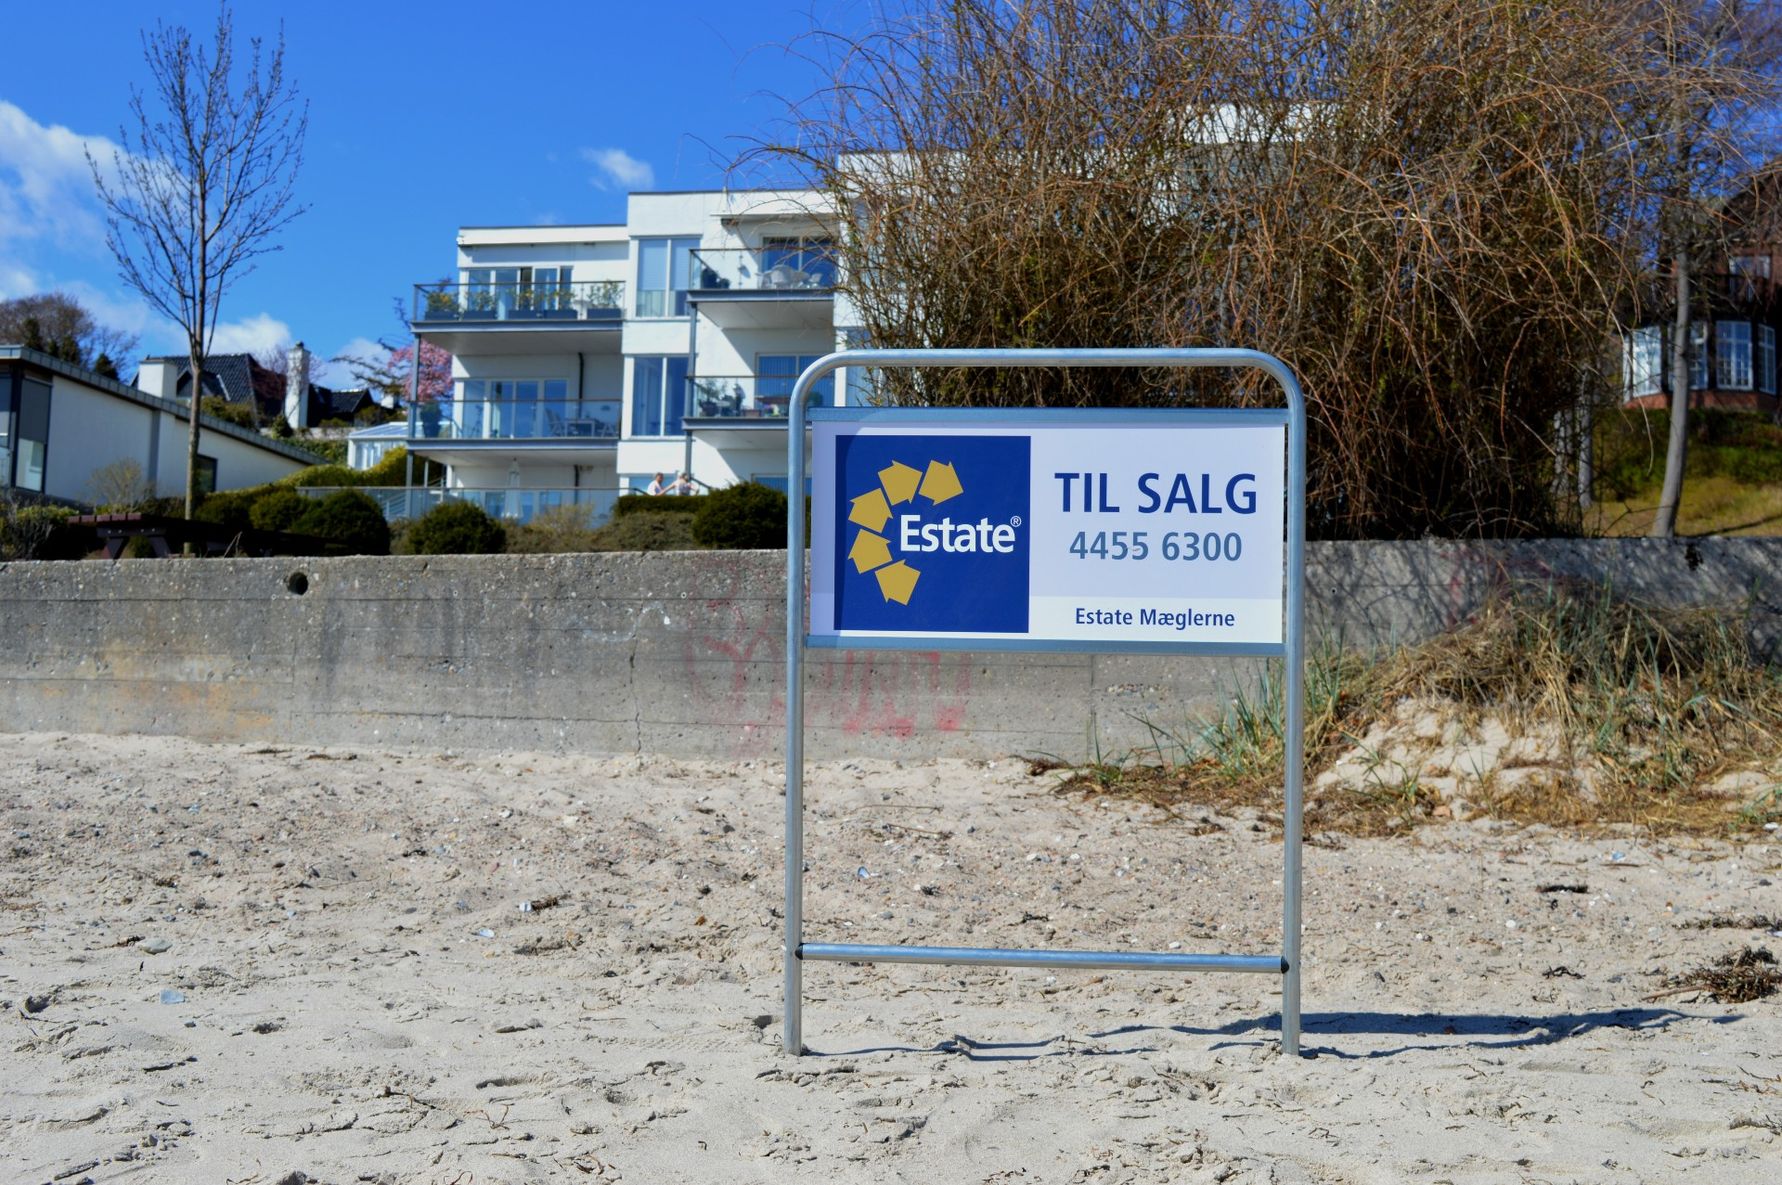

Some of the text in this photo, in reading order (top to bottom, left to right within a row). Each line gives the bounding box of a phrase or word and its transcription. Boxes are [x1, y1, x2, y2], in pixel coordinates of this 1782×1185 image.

[1054, 472, 1257, 515] TIL SALG
[1069, 531, 1243, 562] 4455 6300
[1075, 607, 1236, 631] Estate Mæglerne
